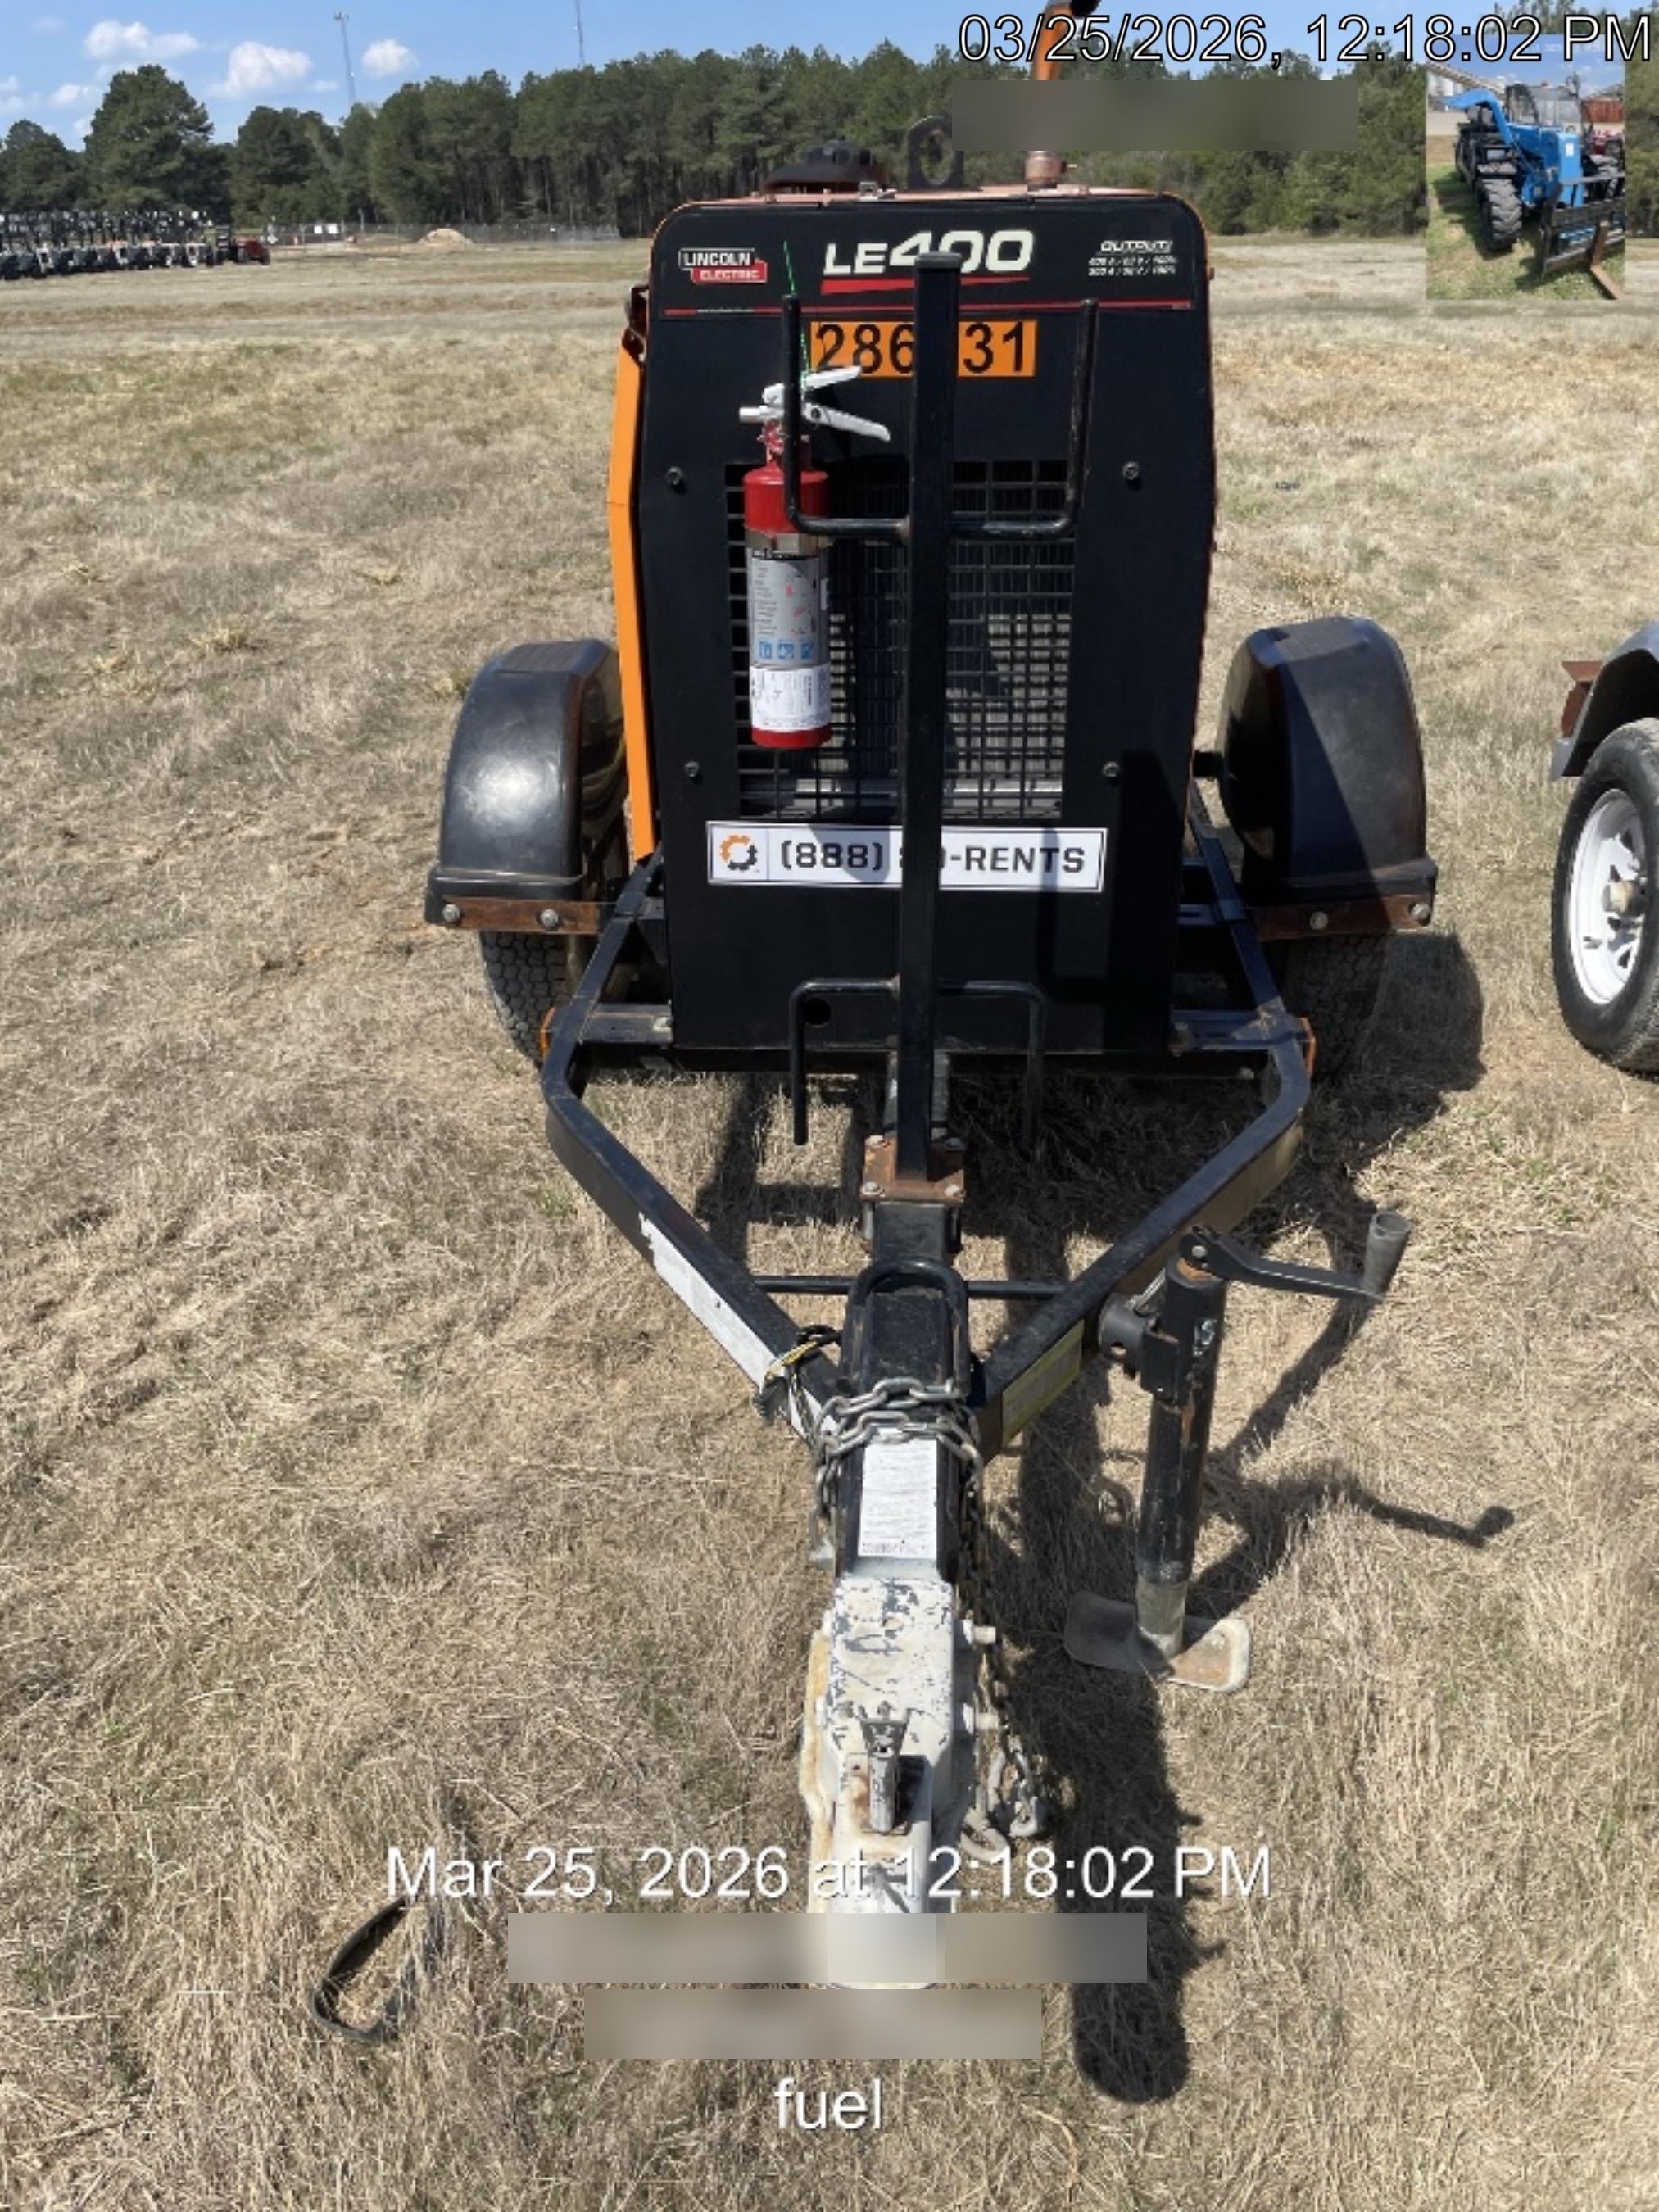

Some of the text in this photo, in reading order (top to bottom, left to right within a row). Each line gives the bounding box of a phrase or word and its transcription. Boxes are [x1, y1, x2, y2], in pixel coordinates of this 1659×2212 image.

[682, 252, 751, 266] LINCOLN
[823, 229, 1035, 275] LE400
[700, 270, 760, 281] ELECTRIC
[815, 321, 1024, 374] 28631
[781, 840, 1086, 873] (888) -RENTS
